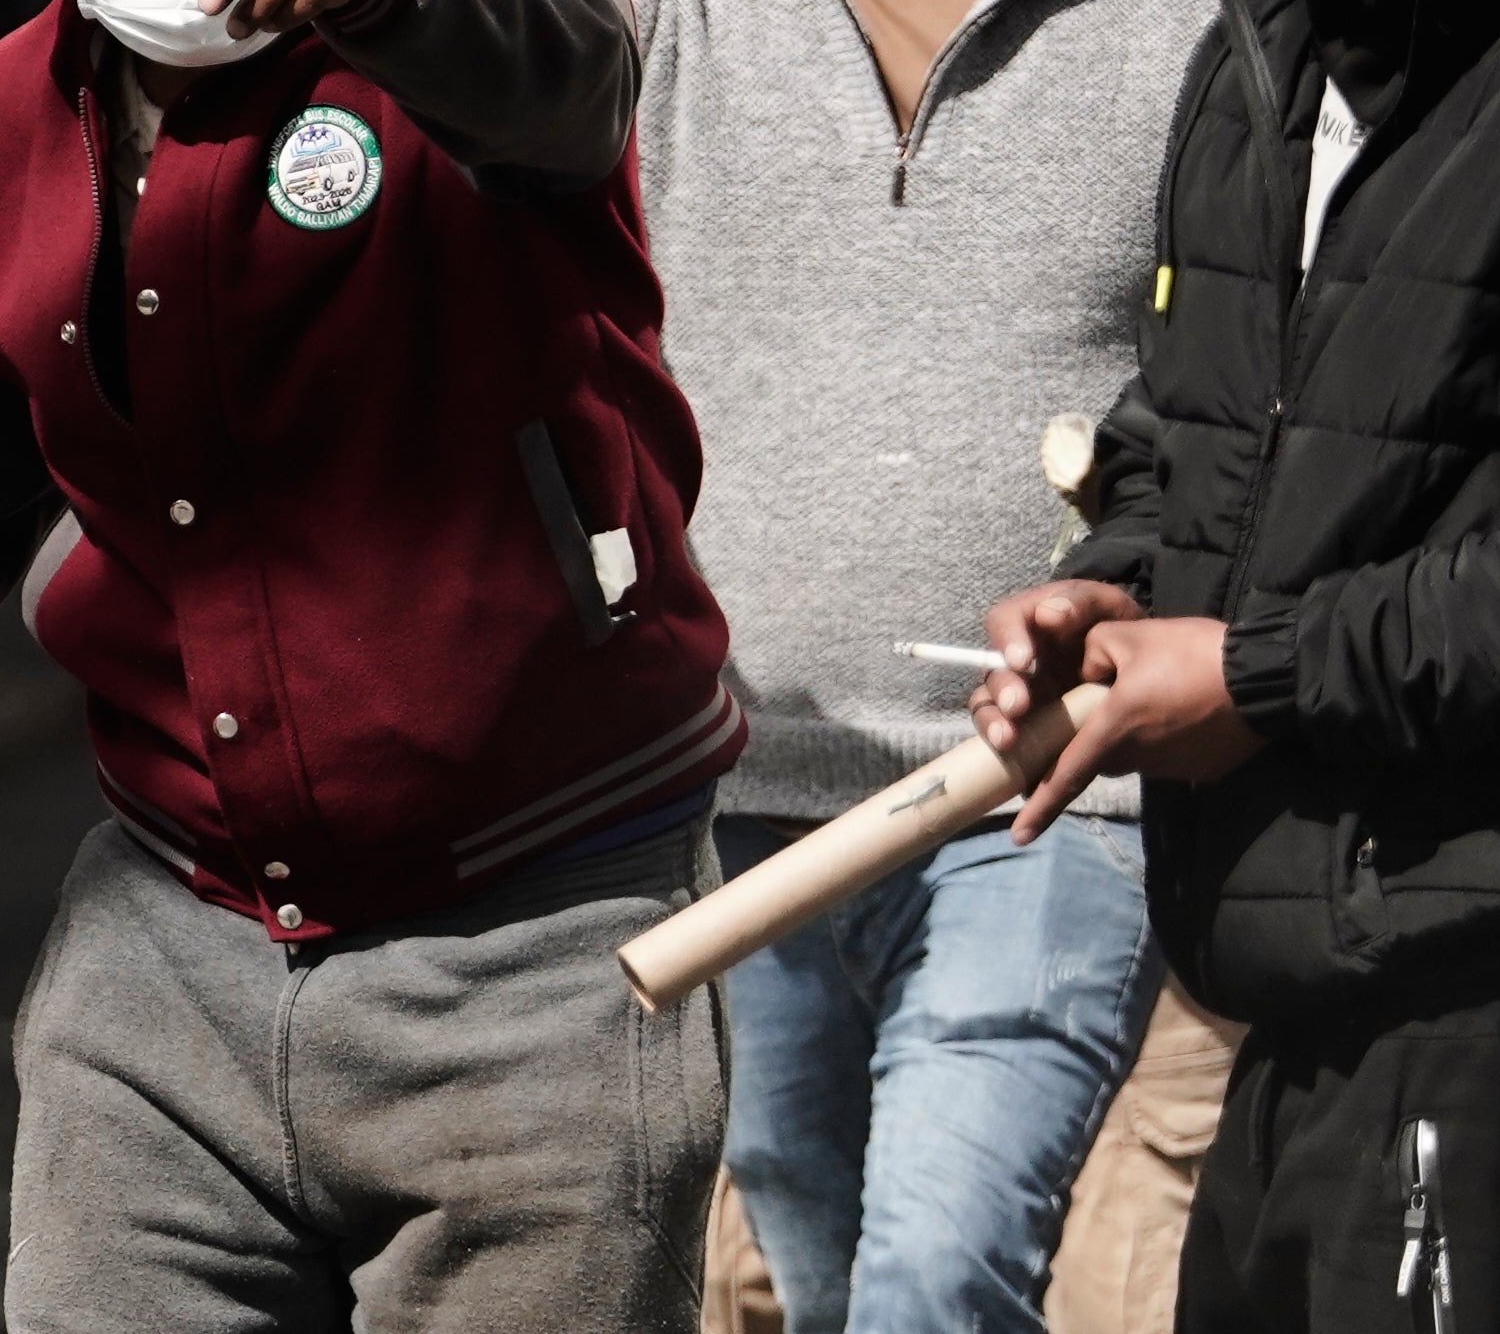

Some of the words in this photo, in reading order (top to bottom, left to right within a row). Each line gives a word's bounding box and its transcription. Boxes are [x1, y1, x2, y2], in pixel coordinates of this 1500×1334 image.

[304, 109, 325, 123] BUS
[327, 109, 368, 142] ESCOLAR
[268, 182, 297, 217] WALDO
[296, 207, 355, 226] BALLIVIAN
[350, 156, 381, 210] TUMARAPI
